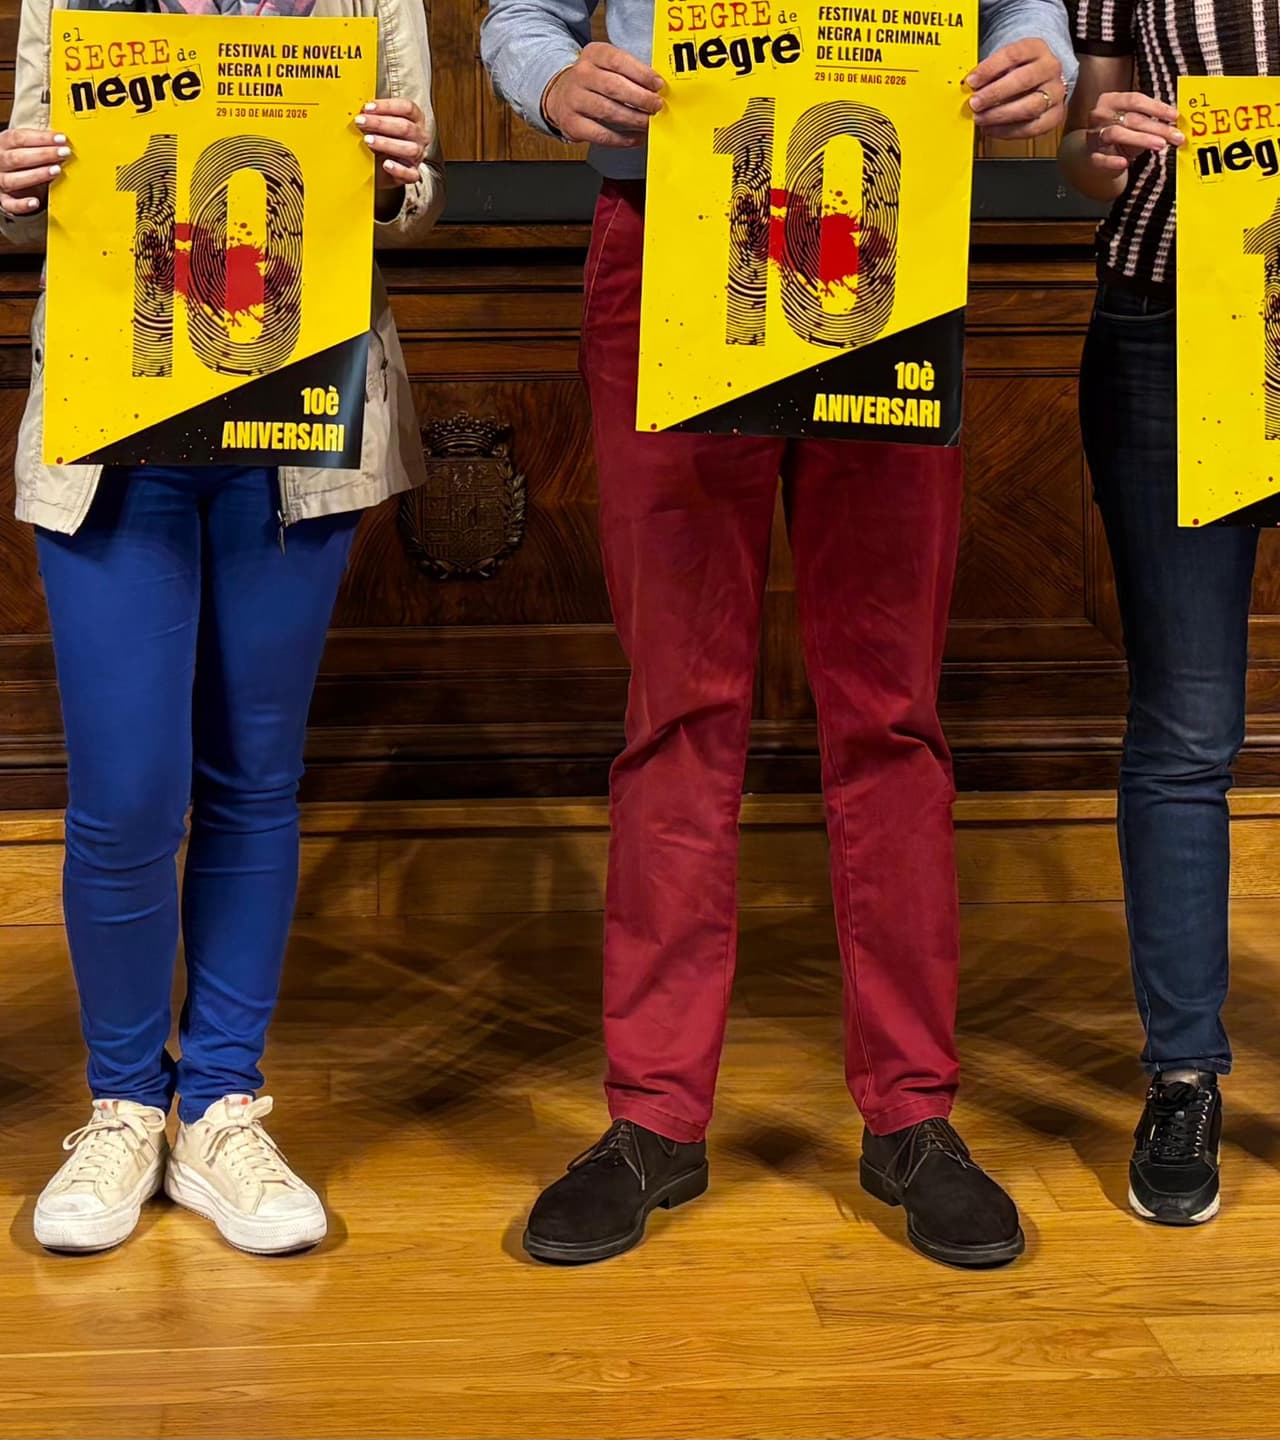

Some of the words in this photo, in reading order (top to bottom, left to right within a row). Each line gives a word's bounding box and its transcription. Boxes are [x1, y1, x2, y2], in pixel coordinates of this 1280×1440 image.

[668, 0, 771, 32] SEGRE
[778, 10, 798, 24] de
[819, 7, 877, 22] FESTIVAL
[883, 10, 900, 24] DE
[63, 28, 83, 42] el
[818, 27, 862, 42] NEGRA
[867, 29, 871, 43] I
[876, 29, 941, 46] CRIMINAL
[65, 39, 170, 71] SEGRE
[177, 48, 197, 61] de
[218, 43, 276, 58] FESTIVAL
[281, 44, 298, 59] DE
[673, 32, 801, 75] negre
[817, 46, 834, 60] DE
[837, 47, 882, 62] LLEIDA
[218, 63, 262, 77] NEGRA
[267, 64, 270, 77] I
[276, 64, 341, 78] CRIMINAL
[815, 72, 825, 81] 29
[833, 73, 845, 82] 30
[847, 74, 858, 83] DE
[860, 74, 882, 84] MAIG
[885, 75, 907, 85] 2026
[71, 68, 202, 114] negre
[217, 82, 235, 96] DE
[238, 83, 283, 97] LLEIDA
[1189, 94, 1210, 108] el
[216, 107, 227, 116] 29
[234, 108, 246, 117] 30
[249, 108, 259, 117] DE
[262, 109, 284, 118] MAIG
[286, 109, 308, 119] 2026
[713, 97, 901, 348] 10
[116, 134, 305, 378] 10
[894, 360, 934, 391] 10è
[301, 386, 339, 415] 10è
[813, 393, 941, 428] ANIVERSARI
[222, 421, 344, 452] ANIVERSARI
